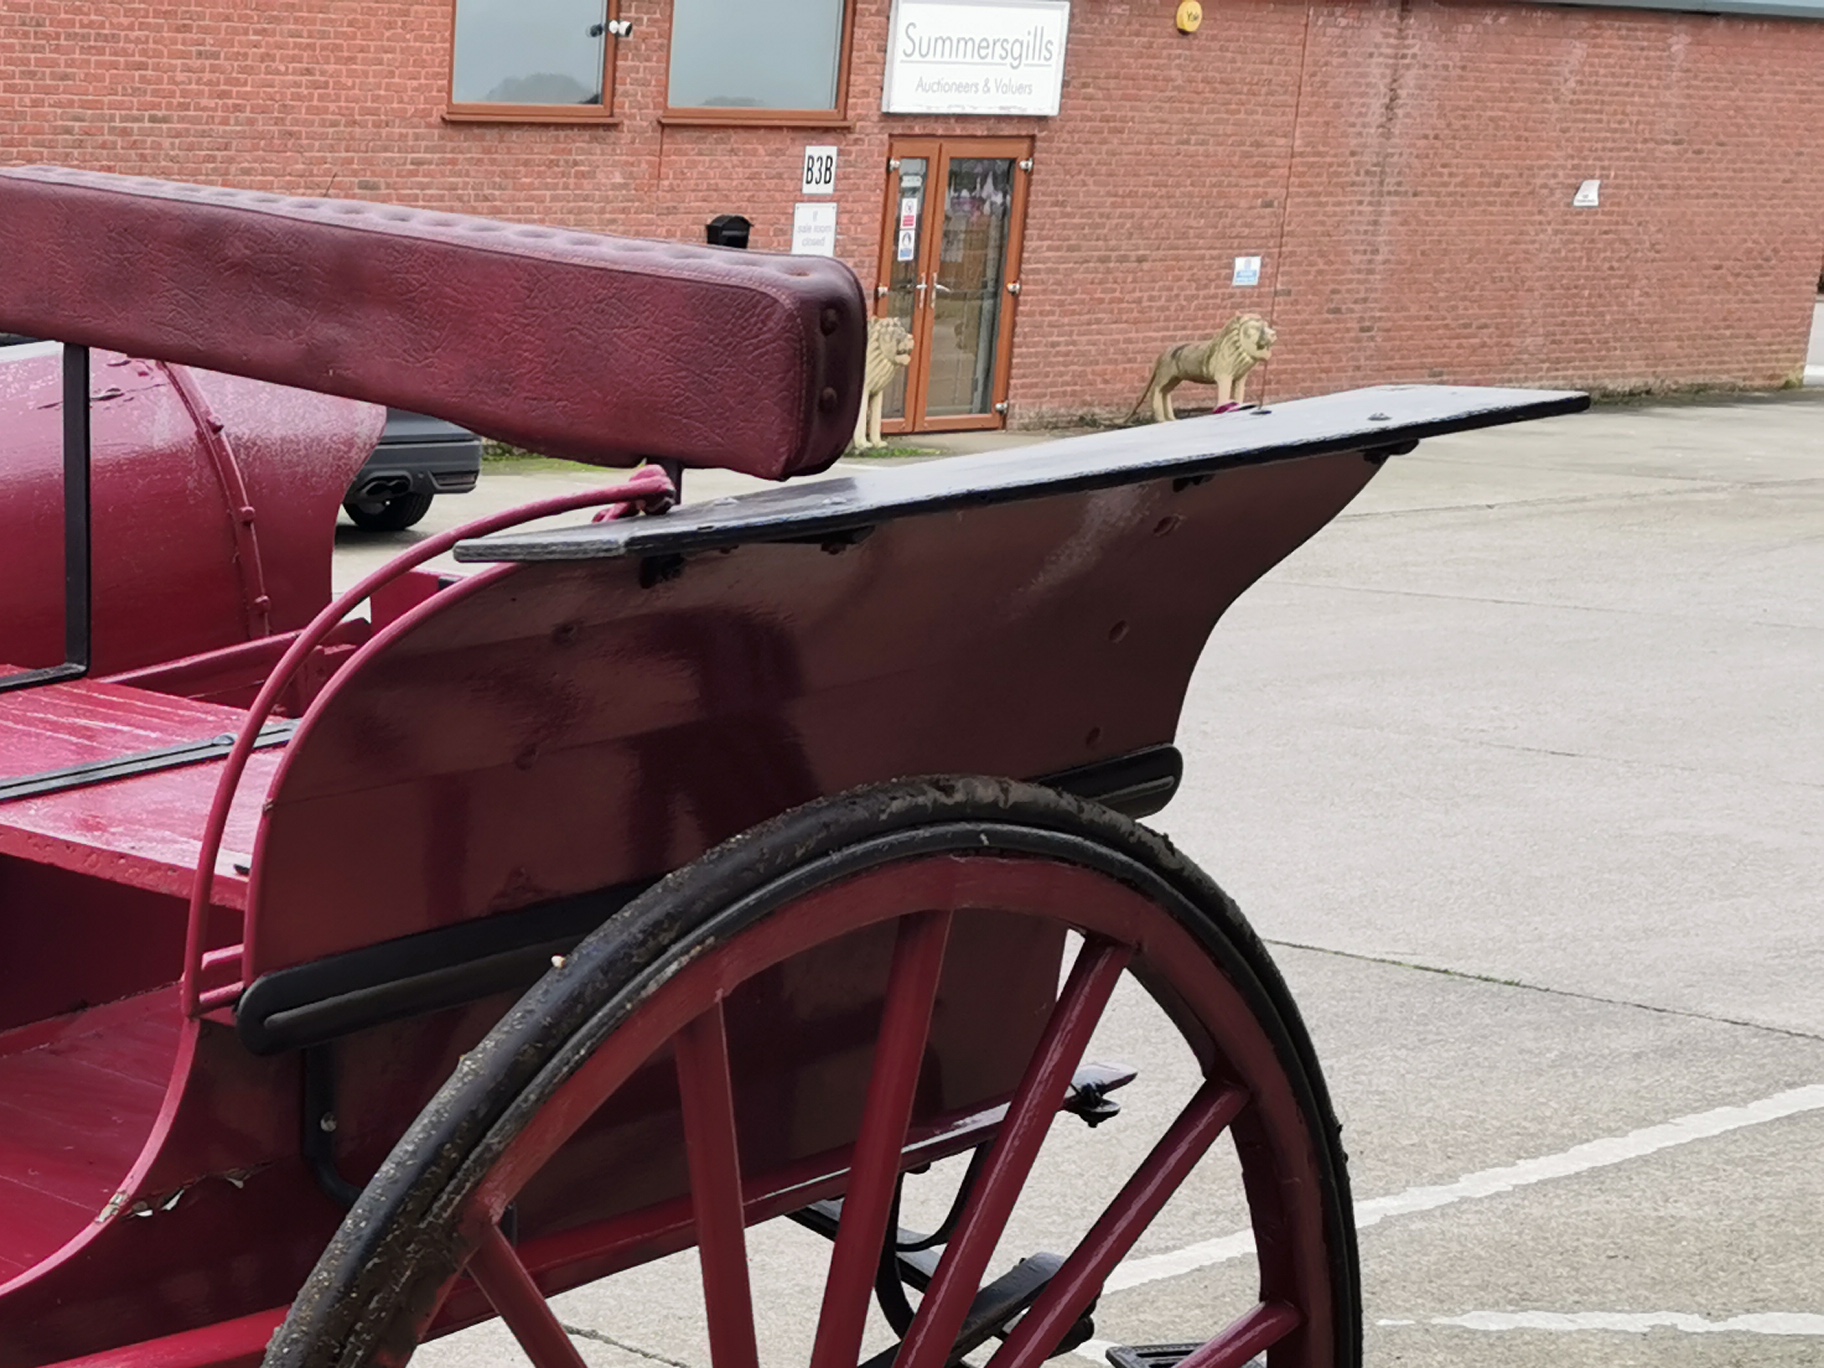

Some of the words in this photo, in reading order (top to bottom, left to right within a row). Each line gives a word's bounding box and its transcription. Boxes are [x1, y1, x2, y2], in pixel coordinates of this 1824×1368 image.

[902, 22, 1054, 69] Summersgills
[915, 76, 979, 95] Auctioneers
[982, 77, 991, 94] &
[994, 77, 1033, 95] Valuers
[805, 155, 833, 185] B3B
